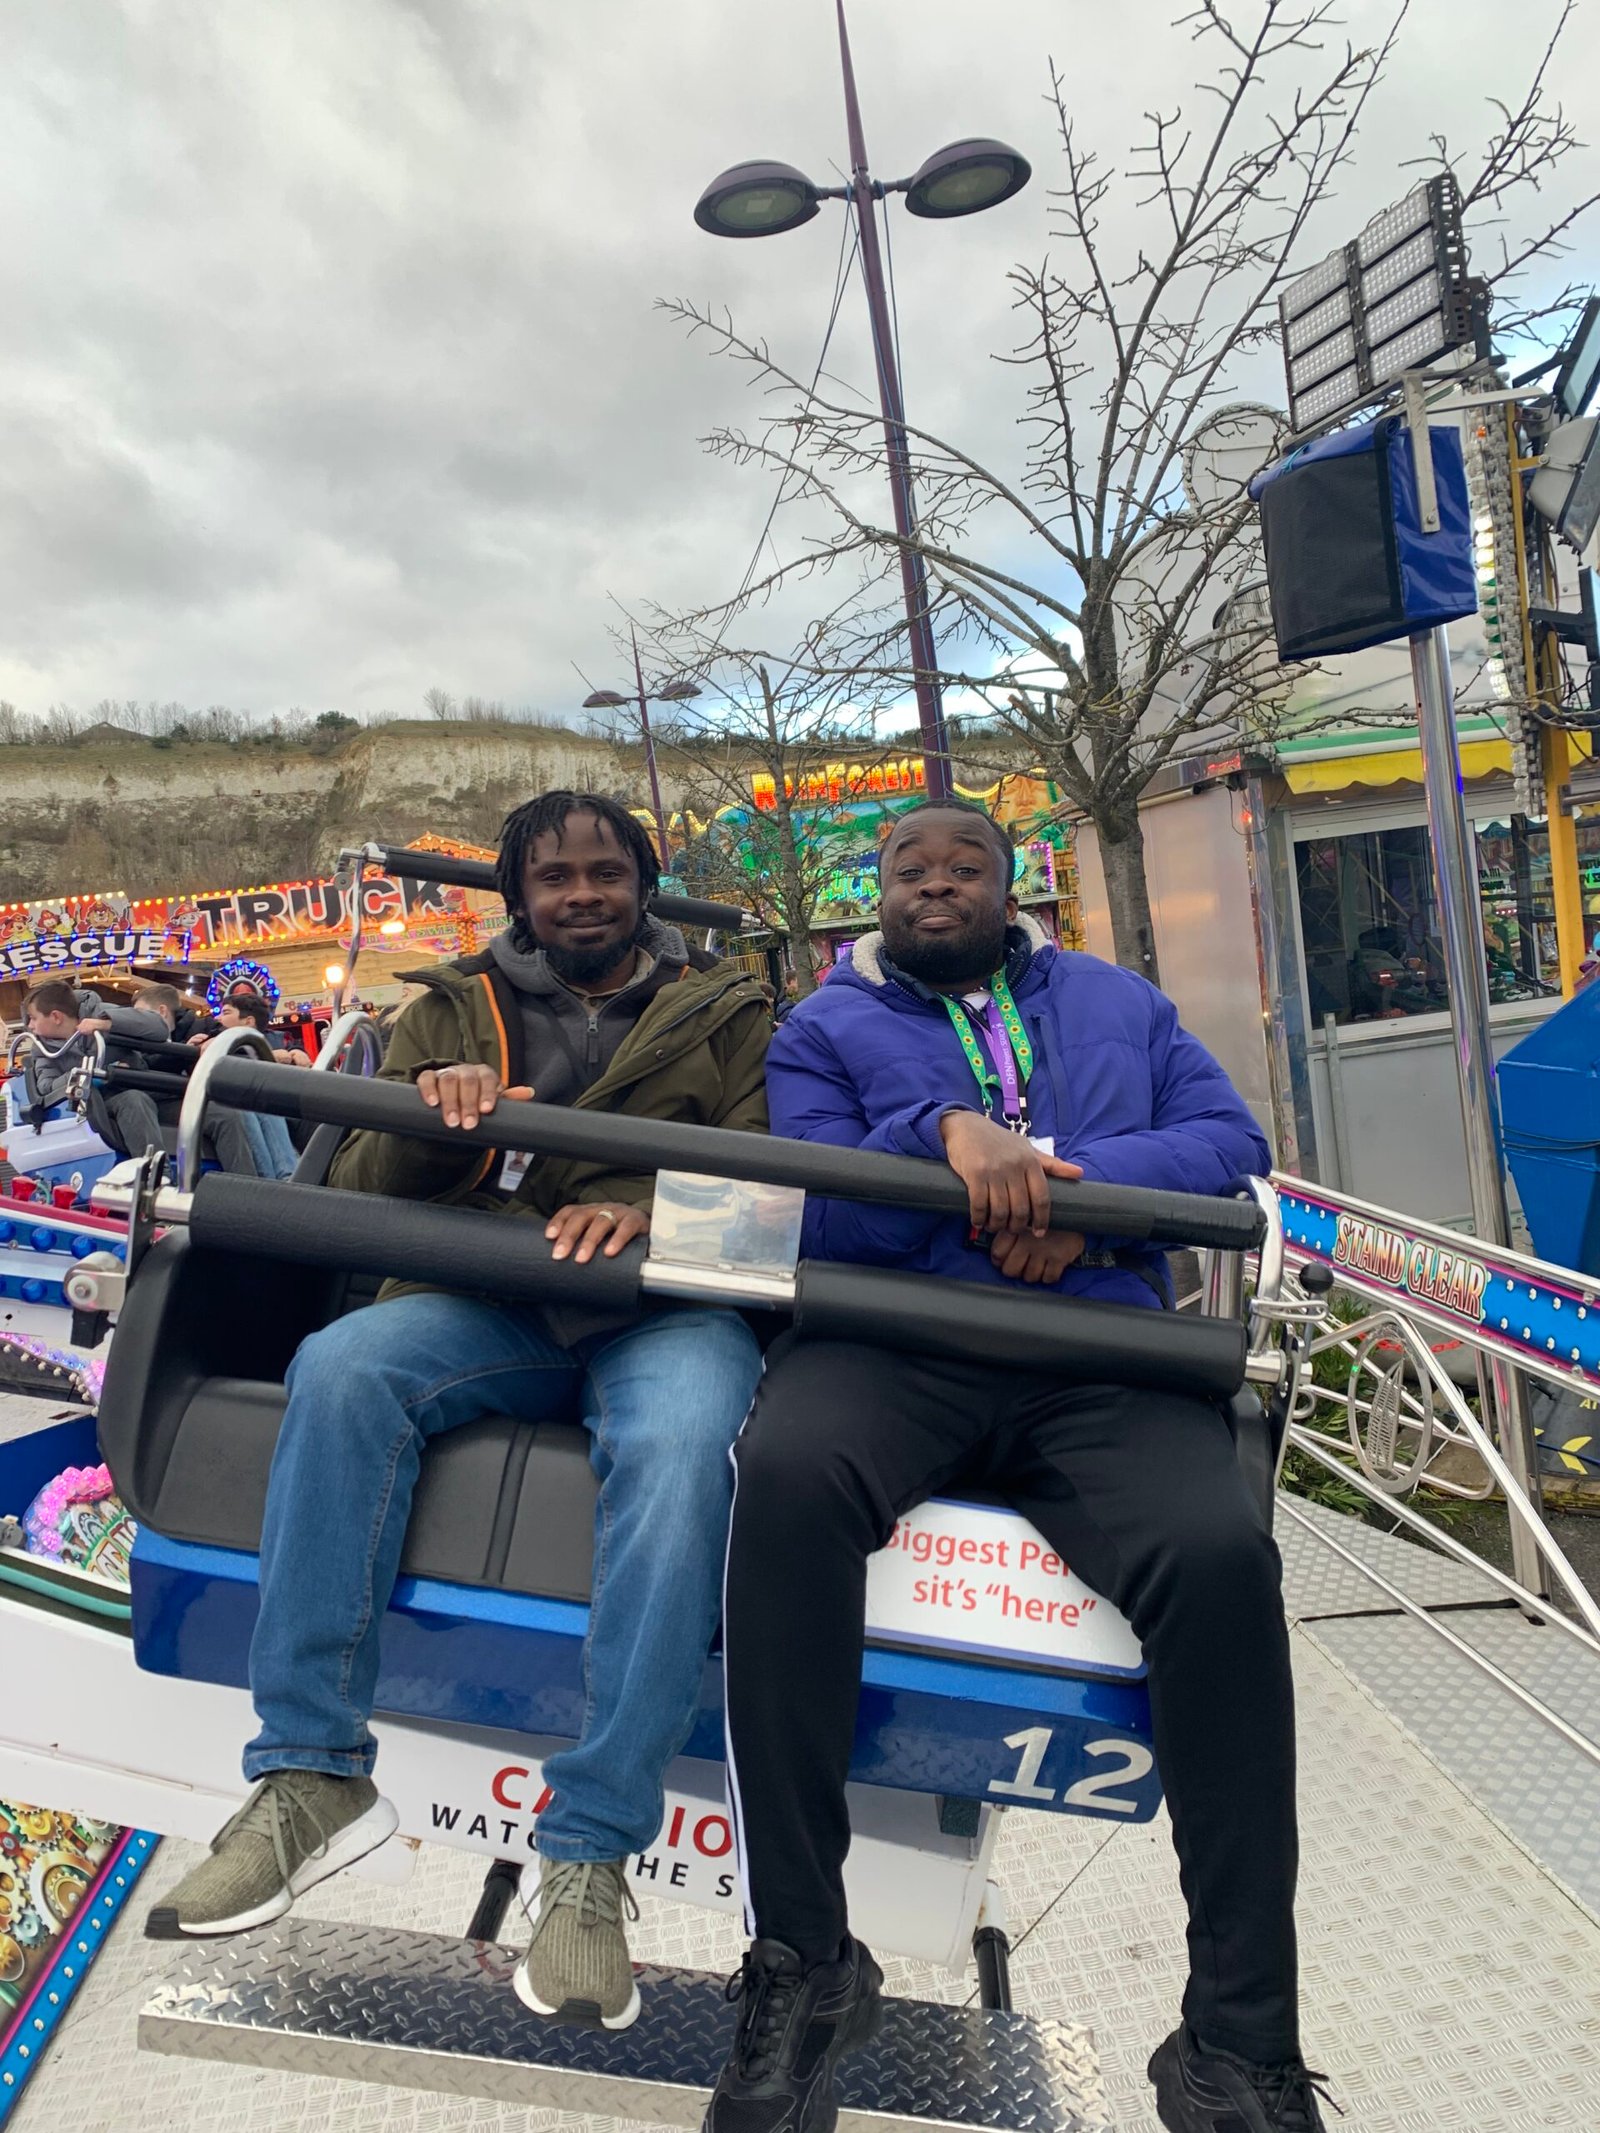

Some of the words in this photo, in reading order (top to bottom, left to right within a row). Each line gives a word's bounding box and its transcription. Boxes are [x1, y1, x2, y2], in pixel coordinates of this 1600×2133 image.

[196, 877, 446, 945] TRUCK
[1006, 1065, 1016, 1085] DFN
[1335, 1215, 1406, 1283] STAND
[1407, 1241, 1486, 1320] CLEAR
[886, 1521, 1009, 1567] Biggest
[1019, 1541, 1071, 1577] Per
[912, 1575, 977, 1611] sit's
[987, 1726, 1154, 1814] 12
[431, 1803, 538, 1852] WAT
[635, 1854, 689, 1887] HE
